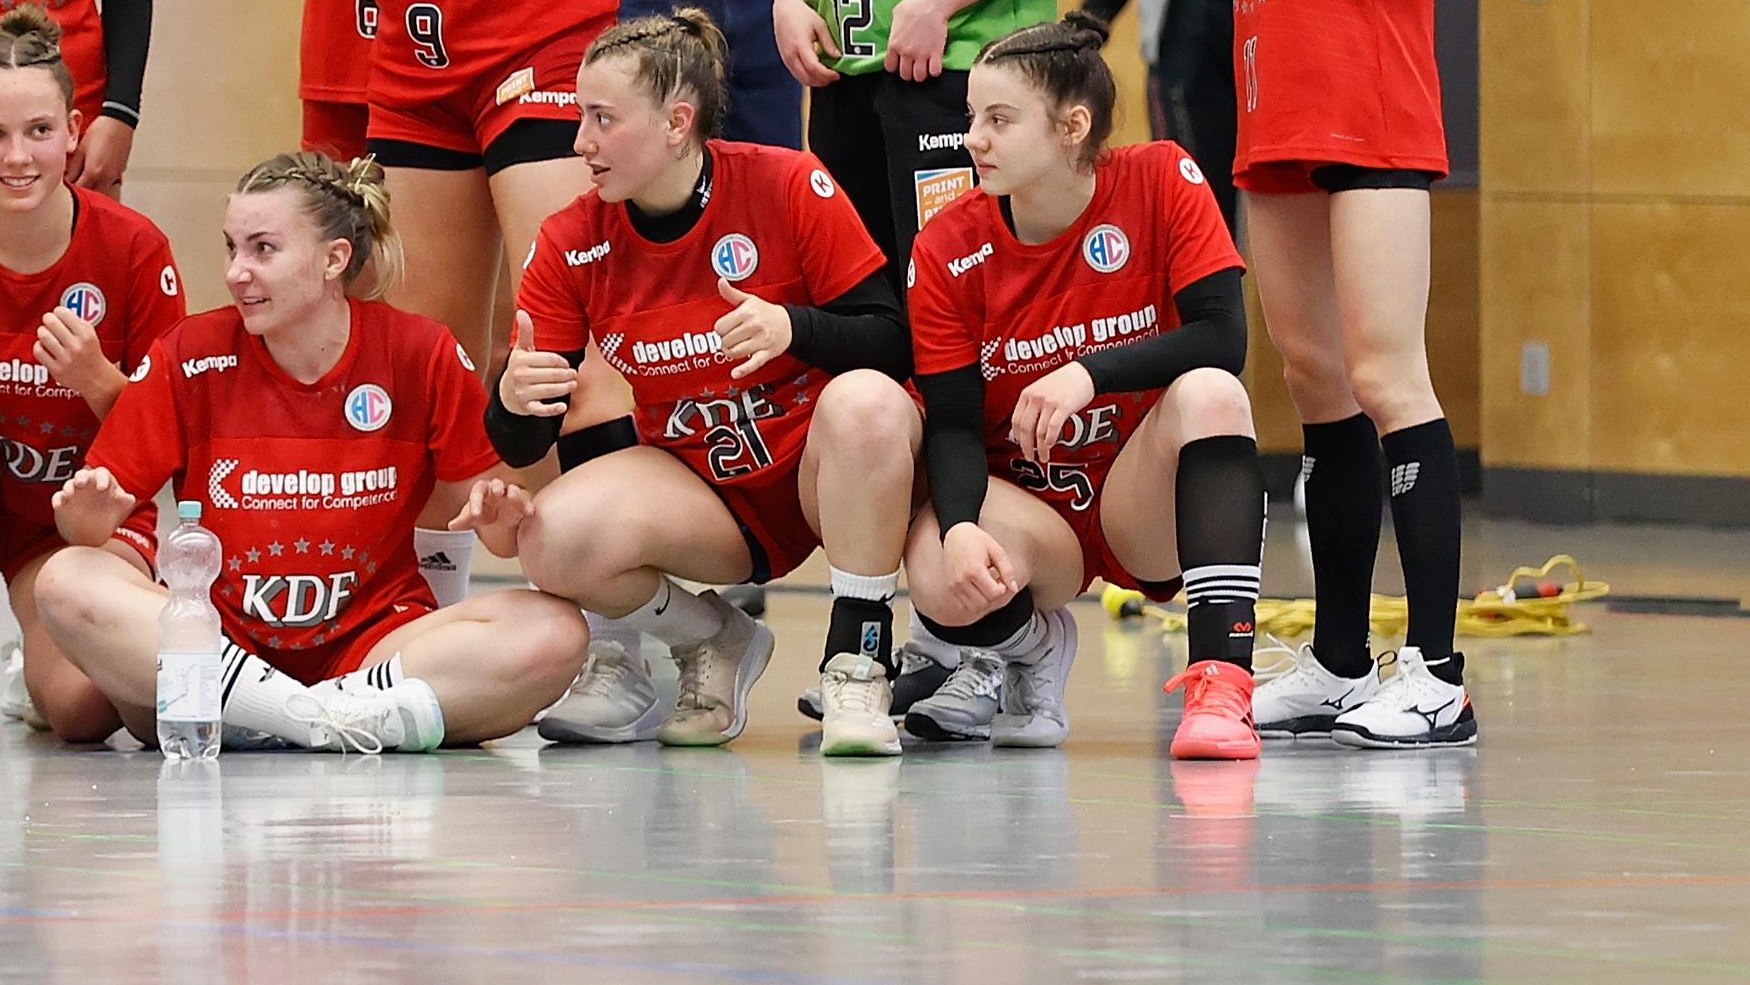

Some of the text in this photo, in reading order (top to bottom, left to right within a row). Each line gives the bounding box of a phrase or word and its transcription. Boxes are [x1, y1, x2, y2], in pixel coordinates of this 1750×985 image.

[405, 3, 450, 69] 9
[918, 133, 969, 151] Kemp
[922, 176, 965, 197] PRINT
[1005, 304, 1157, 362] develop group
[632, 330, 723, 364] develop
[182, 354, 237, 378] Kempa
[638, 361, 690, 377] Connect
[692, 355, 711, 370] for
[1007, 355, 1062, 374] Connect
[14, 383, 31, 396] for
[704, 419, 773, 481] 21
[241, 469, 335, 497] develop
[242, 496, 298, 510] Connect
[301, 495, 319, 509] for
